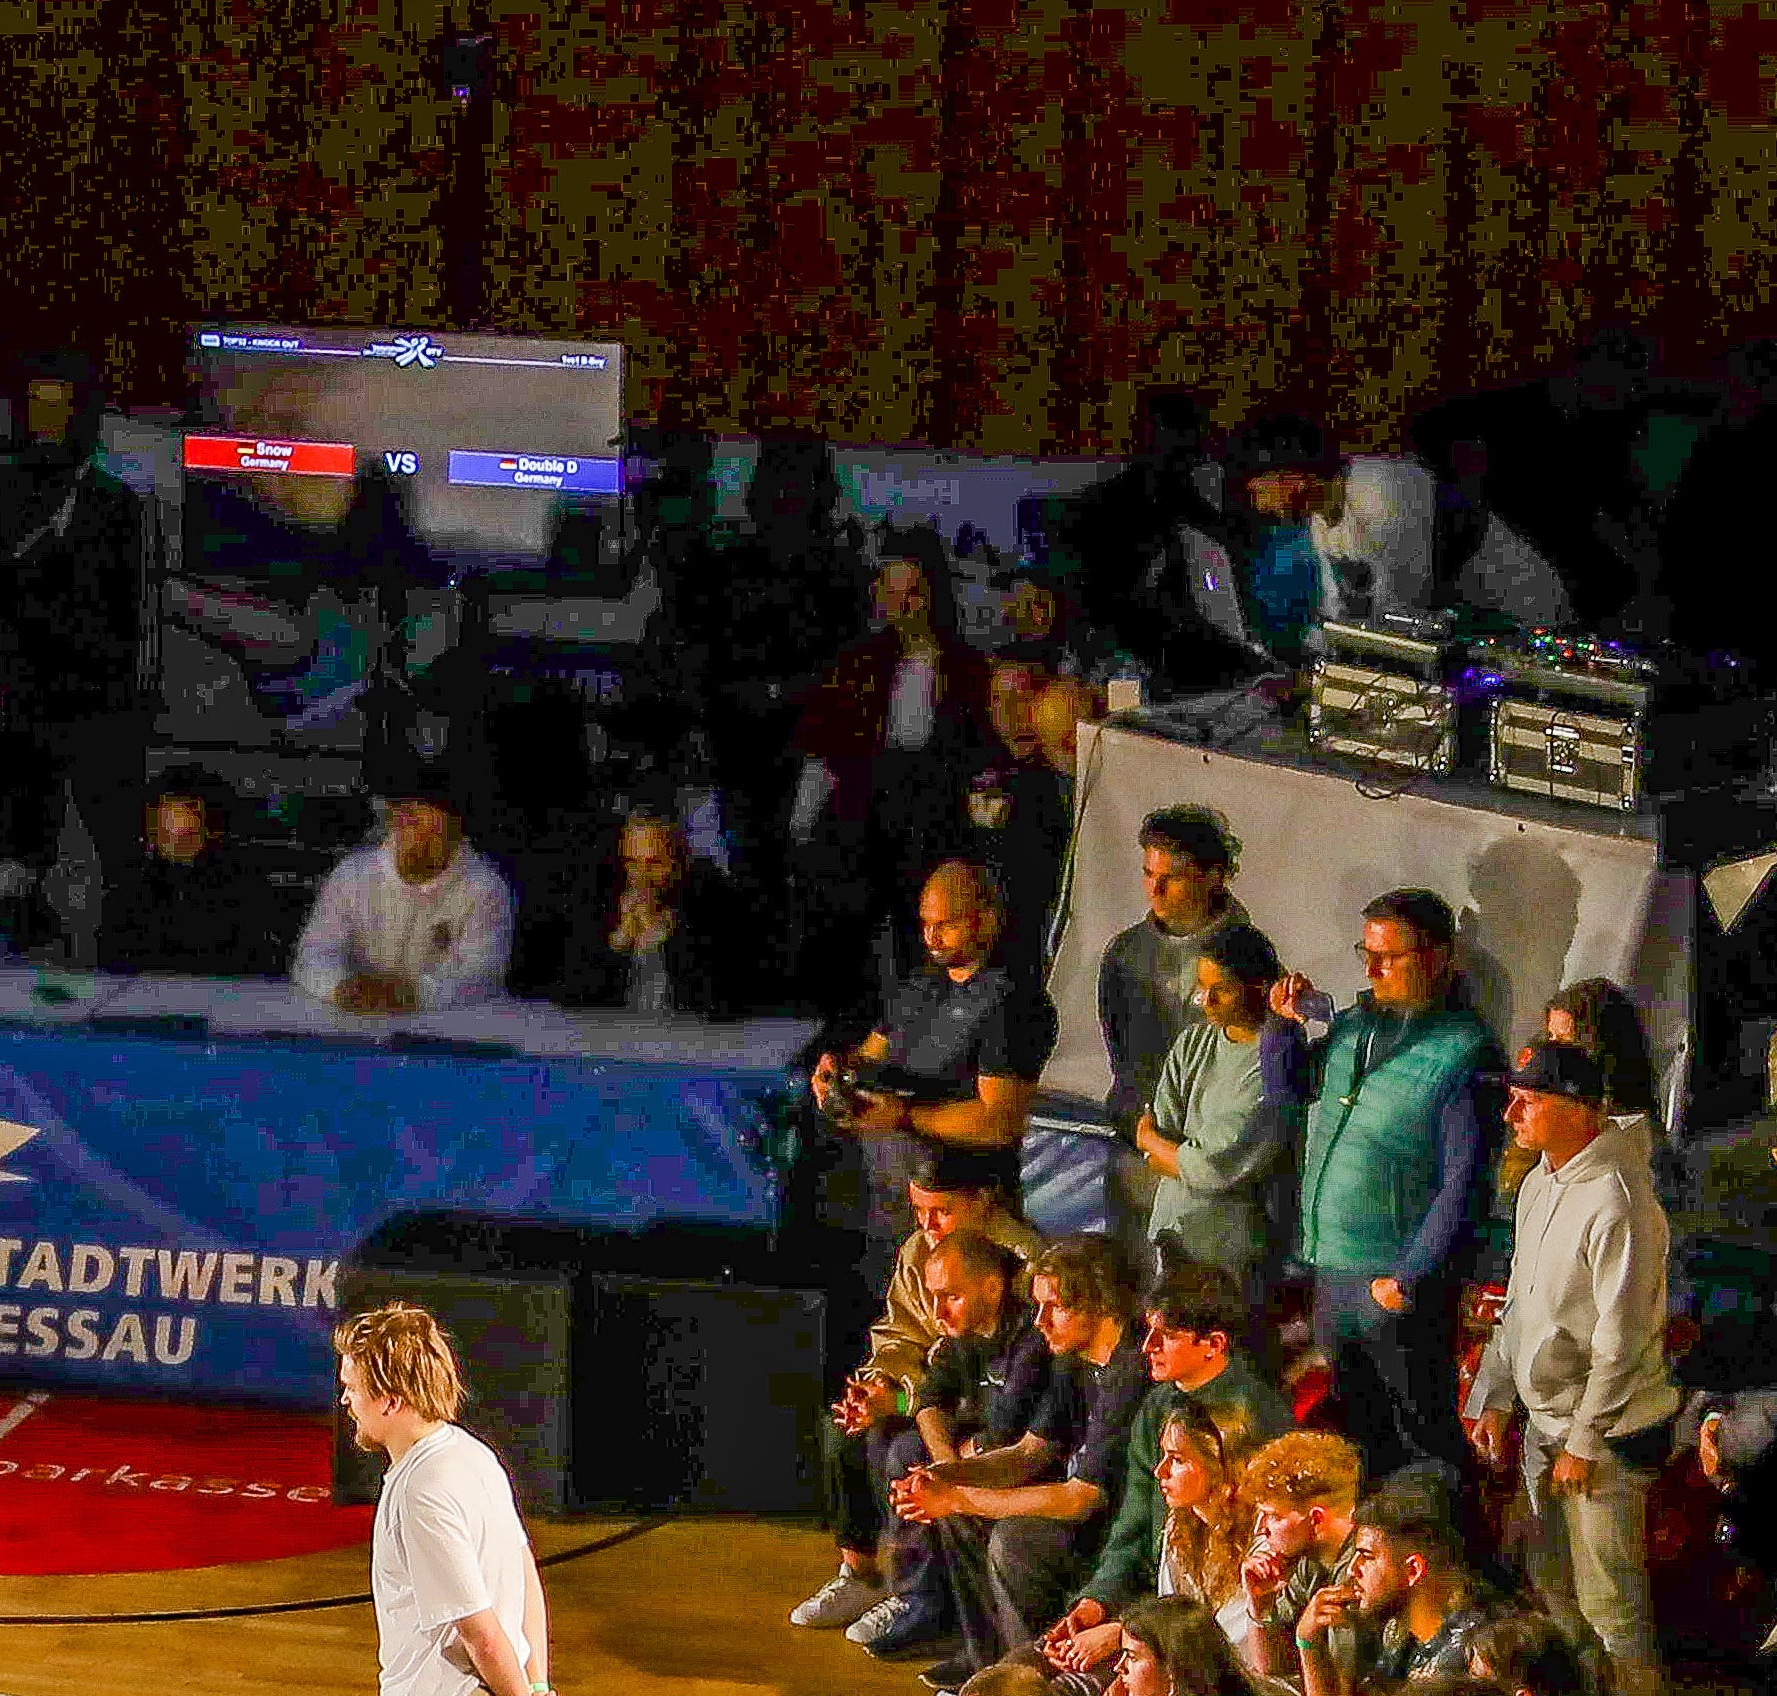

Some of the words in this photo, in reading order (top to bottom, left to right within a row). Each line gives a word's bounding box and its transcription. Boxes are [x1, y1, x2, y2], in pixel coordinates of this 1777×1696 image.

[256, 441, 293, 457] Snow
[240, 455, 290, 472] Germany
[385, 452, 418, 475] VS
[518, 457, 565, 474] Double
[566, 460, 578, 474] D
[513, 471, 564, 489] Germany
